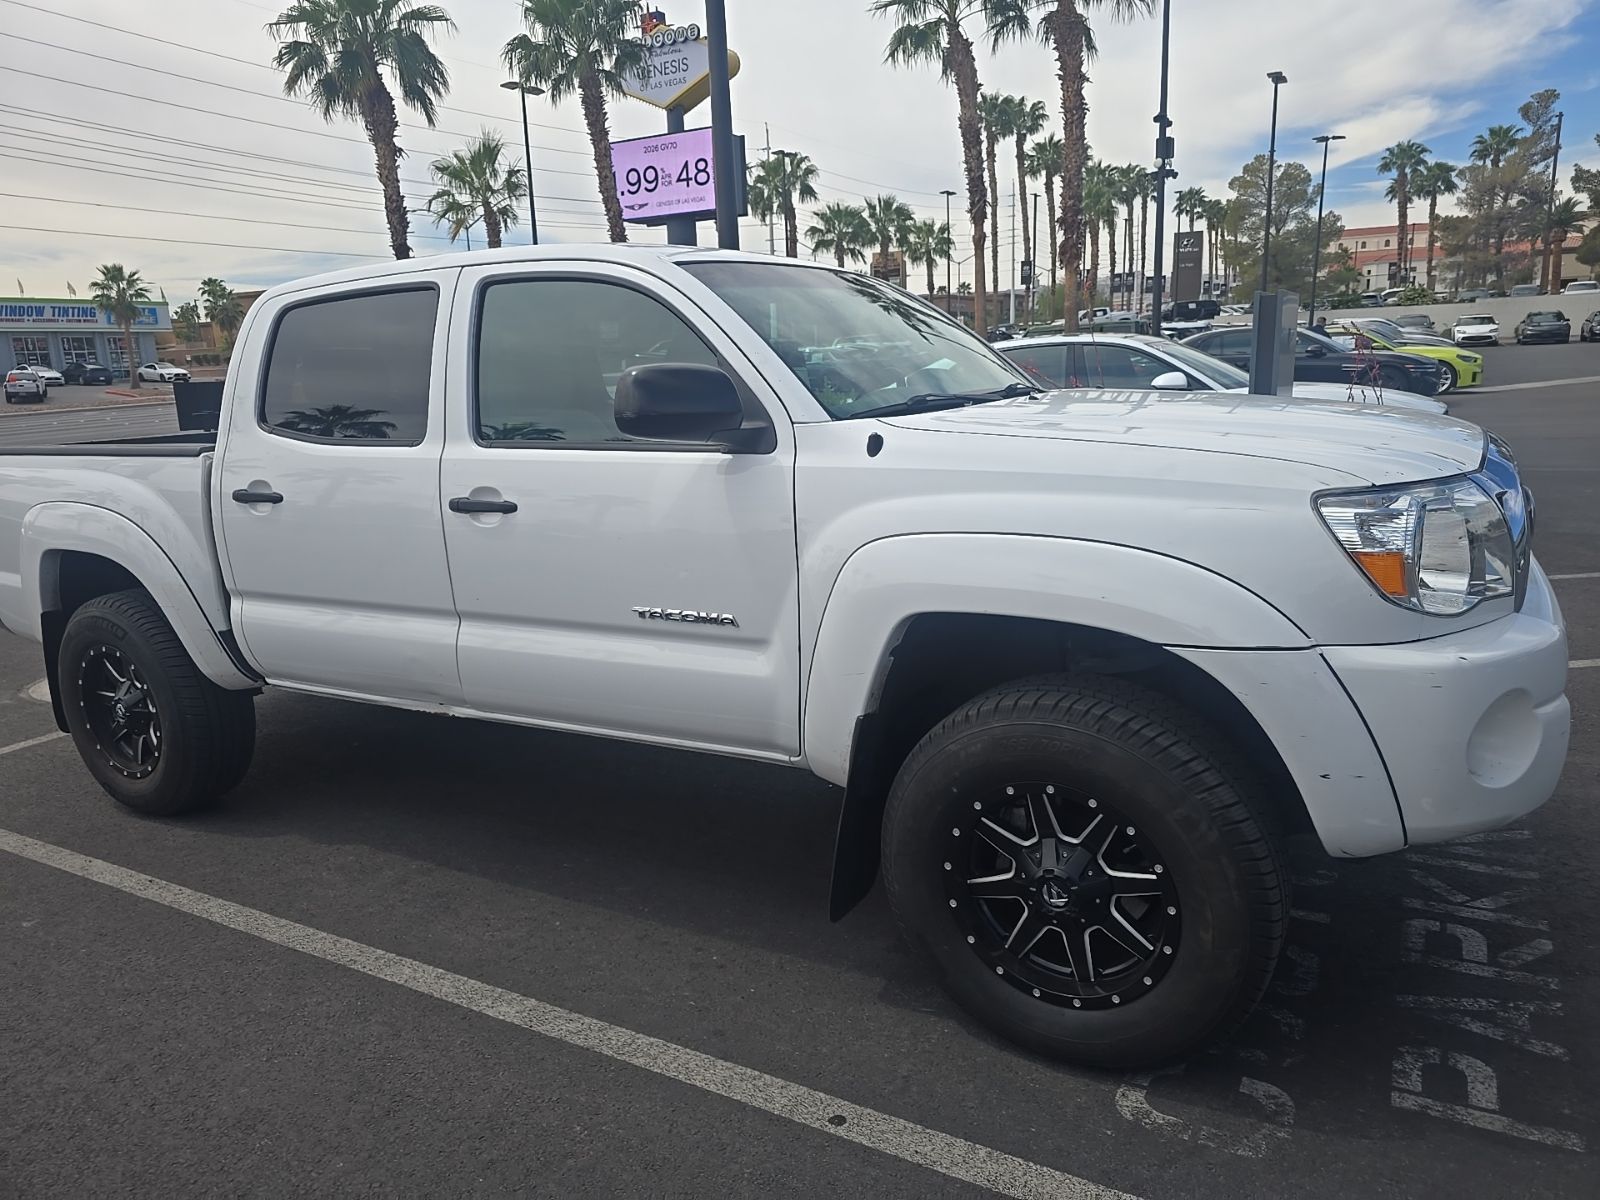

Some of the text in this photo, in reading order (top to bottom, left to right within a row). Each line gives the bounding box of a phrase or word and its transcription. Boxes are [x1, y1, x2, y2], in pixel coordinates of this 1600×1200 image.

[650, 80, 662, 90] LAS
[664, 76, 687, 87] VEGAS
[643, 141, 677, 154] 2026 GV70
[676, 157, 710, 188] 48
[50, 306, 97, 318] TINTING
[632, 606, 740, 628] TACOMA
